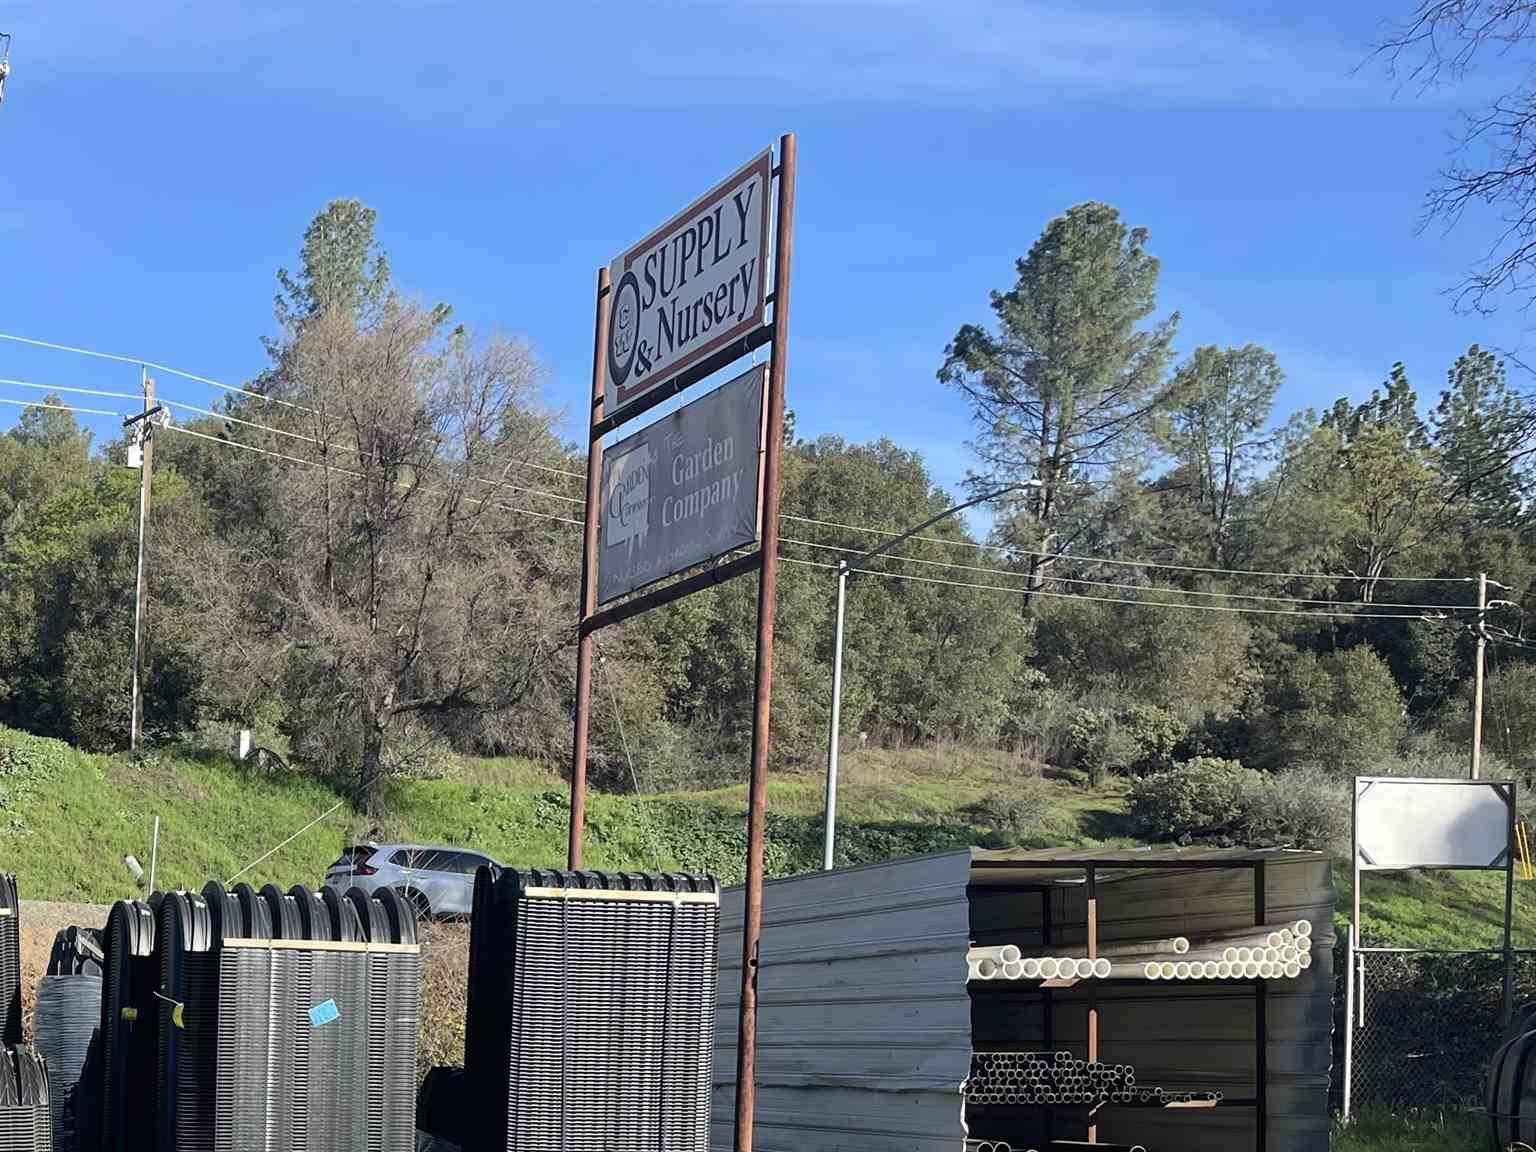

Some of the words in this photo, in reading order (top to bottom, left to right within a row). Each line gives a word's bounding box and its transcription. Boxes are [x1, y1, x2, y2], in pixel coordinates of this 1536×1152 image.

[642, 182, 756, 311] SUPPLY
[635, 339, 654, 377] &
[655, 258, 756, 363] Nursery
[662, 467, 744, 528] Company
[672, 436, 733, 486] Garden
